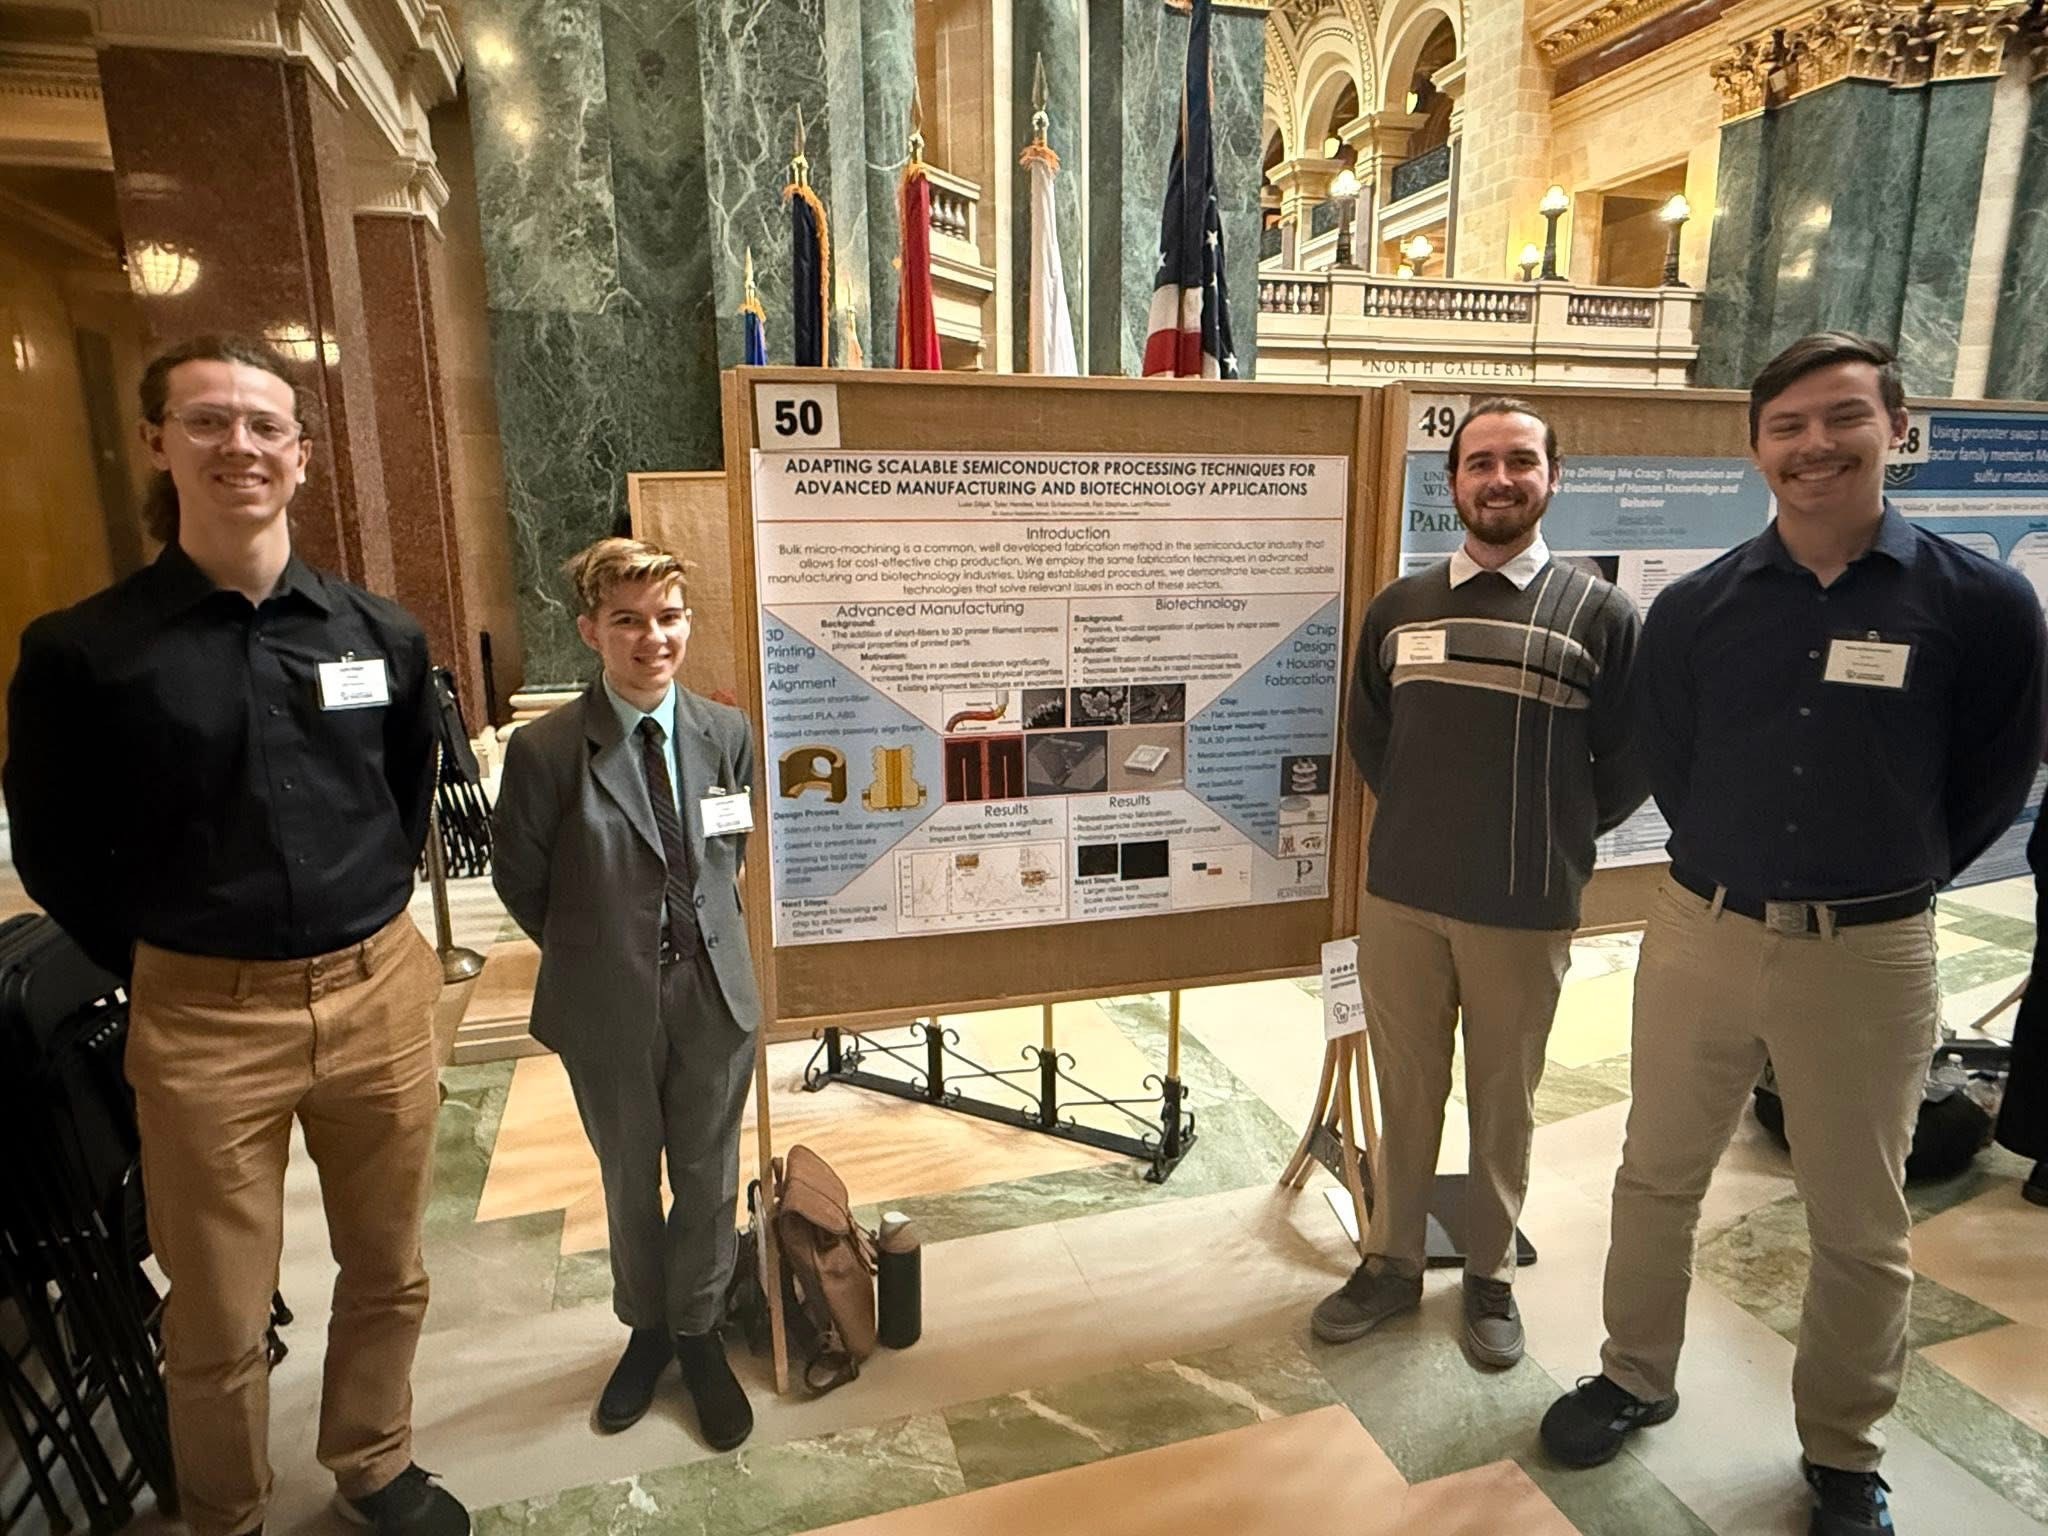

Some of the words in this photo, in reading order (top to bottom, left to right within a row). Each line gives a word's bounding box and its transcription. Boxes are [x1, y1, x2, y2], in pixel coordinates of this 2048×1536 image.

[1370, 359, 1434, 374] NORTH
[1443, 361, 1525, 377] GALLERY
[775, 399, 823, 436] 50
[1419, 406, 1455, 438] 49
[1932, 425, 1960, 442] Using
[785, 458, 873, 473] ADAPTING
[878, 460, 958, 474] SCALABLE
[962, 460, 1099, 475] SEMICONDUCTOR
[1104, 461, 1197, 476] PROCESSING
[1200, 462, 1285, 477] TECHNIQUES
[1289, 463, 1316, 477] FOR
[1577, 467, 1616, 480] Drilling
[1424, 471, 1448, 482] UNI
[795, 480, 892, 495] ADVANCED
[896, 480, 1036, 495] MANUFACTURING
[1041, 481, 1076, 495] AND
[1080, 481, 1206, 496] BIOTECHNOLOGY
[1210, 482, 1308, 497] APPLICATIONS
[1563, 482, 1613, 493] Evolution
[1026, 527, 1110, 540] Introduction
[804, 544, 900, 556] micro-machining
[904, 544, 911, 553] is
[912, 545, 922, 553] a
[924, 543, 976, 553] common,
[979, 541, 1001, 551] well
[1003, 541, 1062, 553] developed
[1064, 540, 1120, 551] fabrication
[1123, 540, 1162, 551] method
[1164, 540, 1174, 550] in
[1176, 540, 1192, 550] the
[1194, 540, 1266, 549] semiconductor
[1305, 540, 1326, 549] that
[799, 558, 834, 568] allows
[837, 557, 851, 568] for
[855, 557, 931, 568] cost-effective
[934, 556, 958, 567] chip
[961, 556, 1022, 567] production.
[1026, 556, 1042, 565] We
[1045, 555, 1085, 567] employ
[1087, 555, 1104, 565] the
[1107, 556, 1134, 564] same
[1137, 553, 1190, 564] fabrication
[1193, 553, 1246, 564] techniques
[1248, 553, 1257, 562] in
[1258, 552, 1309, 562] advanced
[903, 584, 973, 596] technologies
[976, 583, 997, 593] that
[1000, 583, 1027, 593] solve
[1029, 582, 1071, 593] relevant
[1074, 582, 1101, 592] issues
[1103, 581, 1113, 591] in
[1116, 580, 1143, 591] each
[1145, 580, 1157, 591] of
[1159, 579, 1184, 589] these
[1187, 579, 1224, 590] sectors.
[836, 603, 917, 617] Advanced
[920, 601, 1025, 616] Manufacturing
[1155, 598, 1248, 612] Biotechnology
[766, 629, 784, 642] 3D
[1306, 623, 1337, 637] Chip
[767, 644, 816, 659] Printing
[1293, 640, 1337, 655] Design
[768, 662, 800, 675] Fiber
[1286, 659, 1336, 672] Housing
[768, 676, 837, 693] Alignment
[1264, 674, 1336, 687] Fabrication
[1109, 795, 1151, 808] Results
[984, 803, 1030, 817] Results
